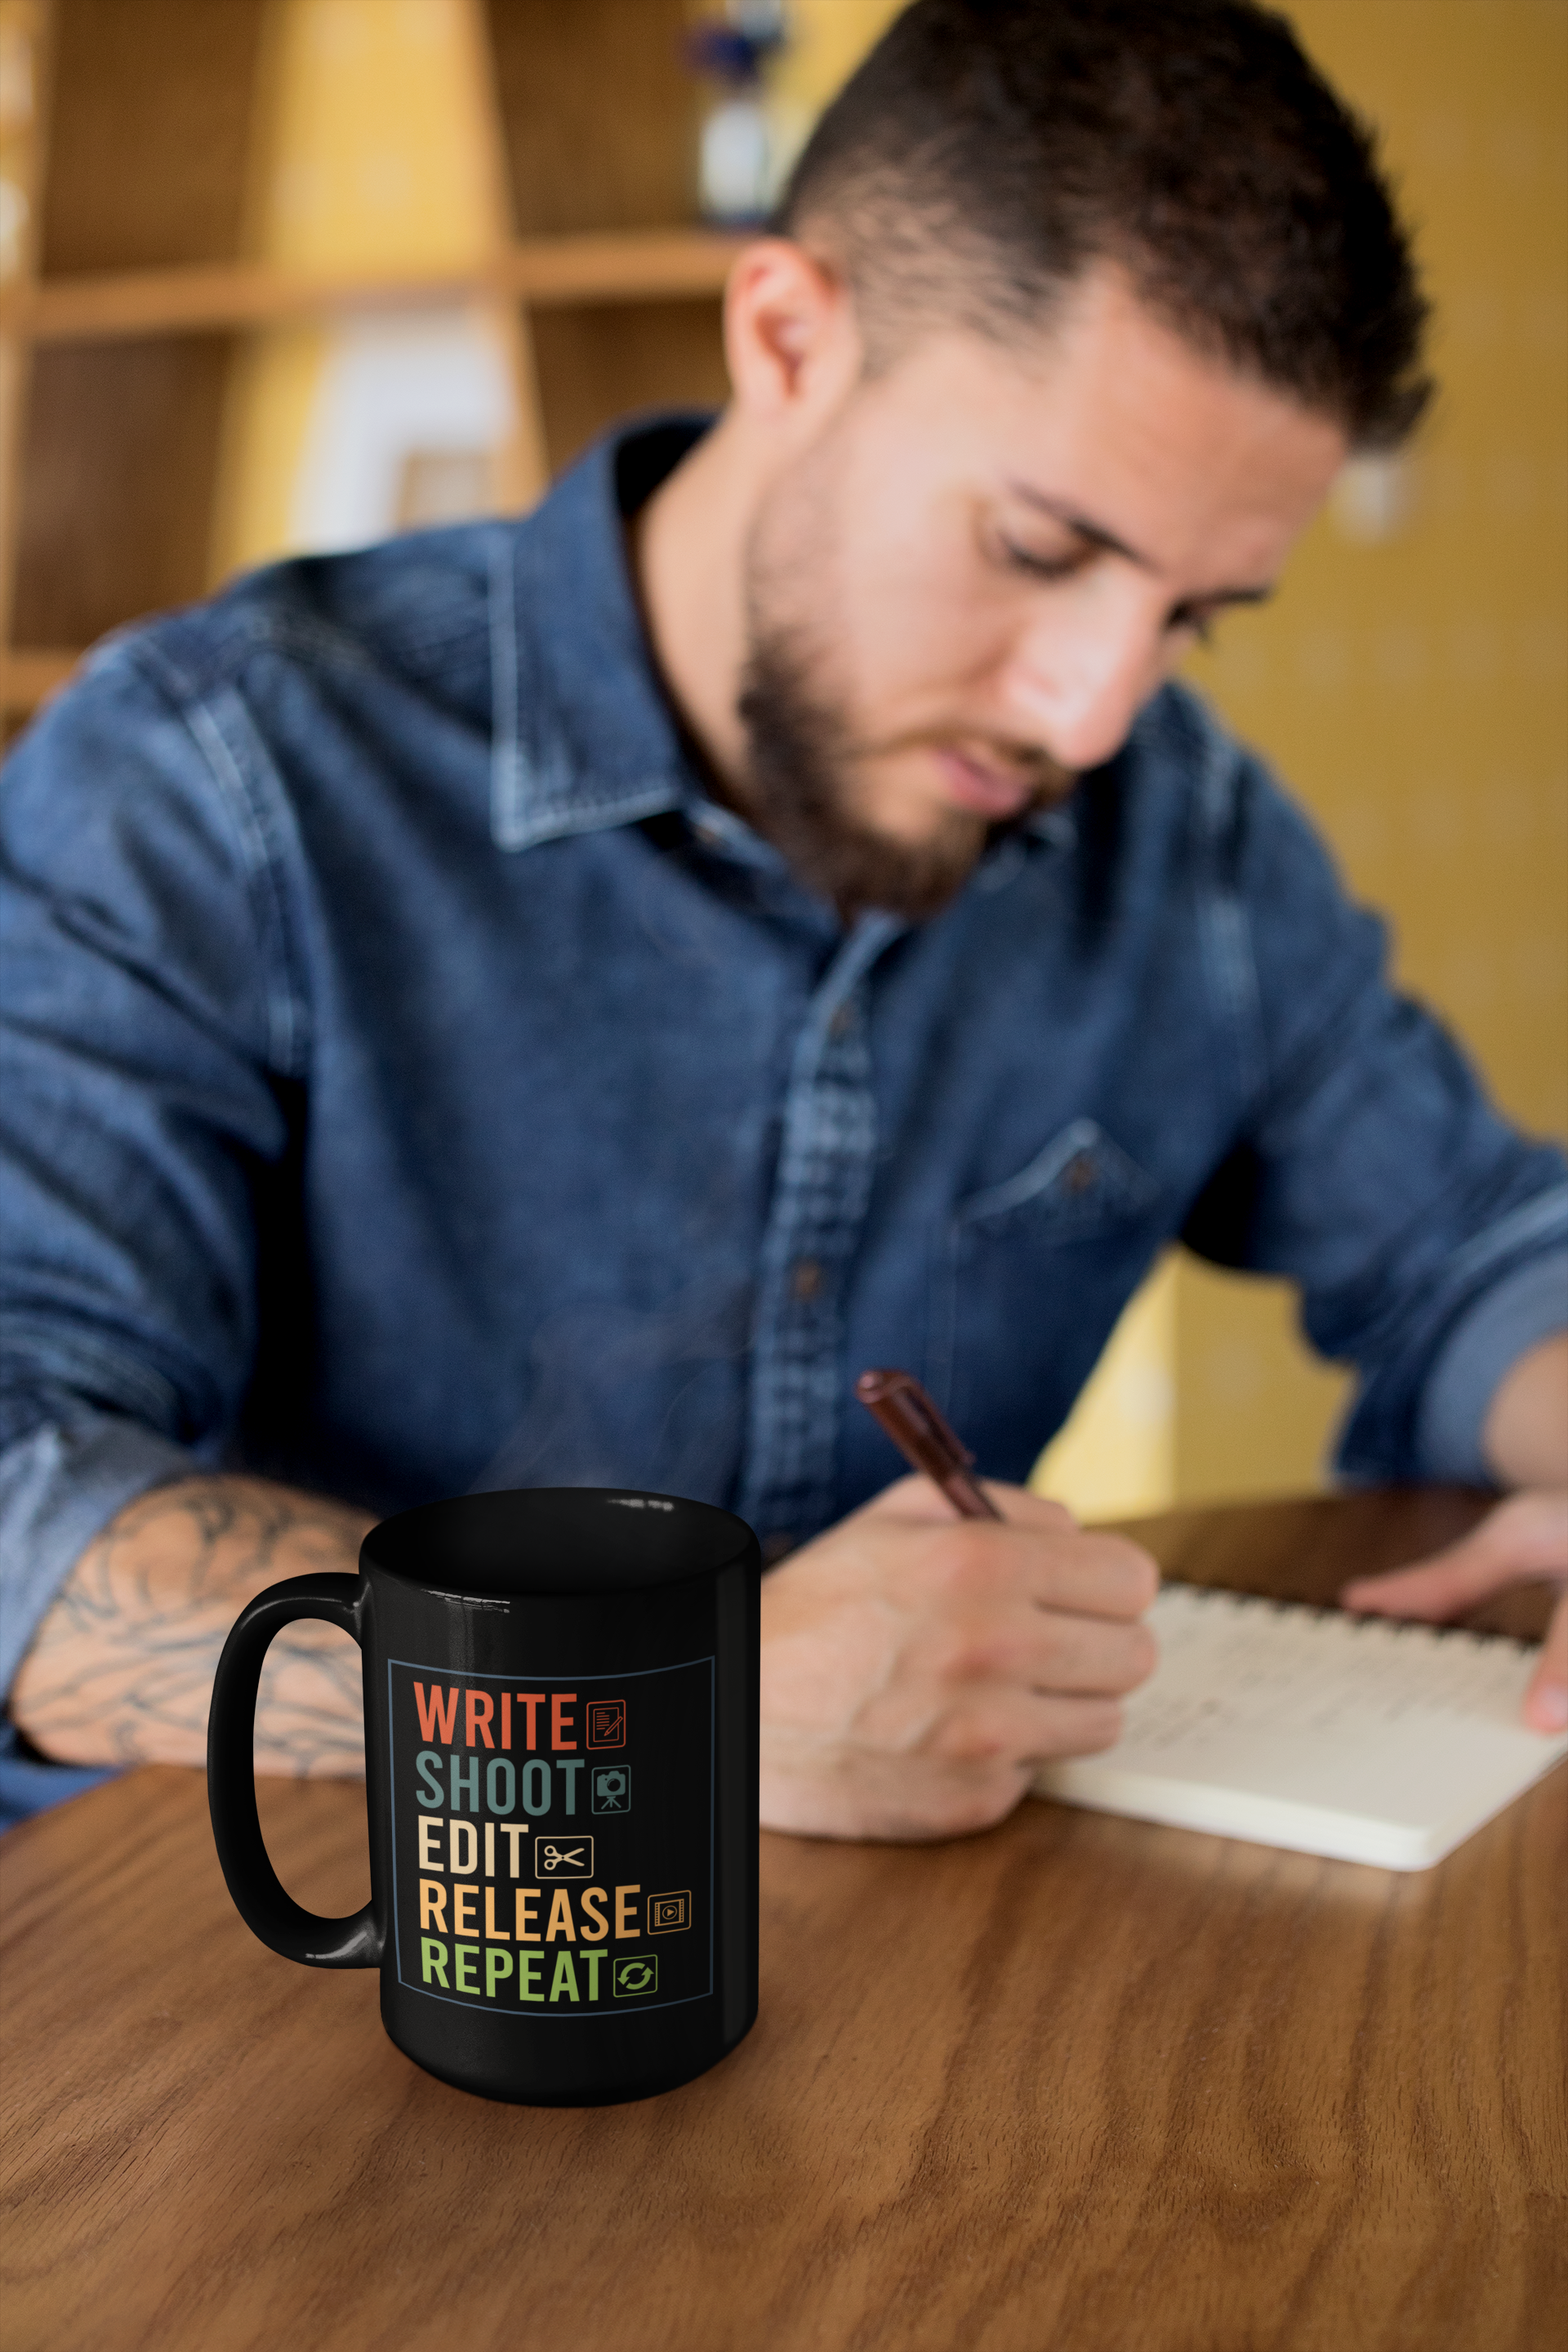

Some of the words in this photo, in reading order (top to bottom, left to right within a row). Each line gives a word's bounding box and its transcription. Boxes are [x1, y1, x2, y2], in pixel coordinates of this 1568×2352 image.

[413, 1682, 577, 1750] WRITE
[416, 1750, 585, 1816] SHOOT
[418, 1815, 529, 1878] EDIT
[419, 1878, 641, 1942] RELEASE
[421, 1936, 608, 2002] REPEAT
